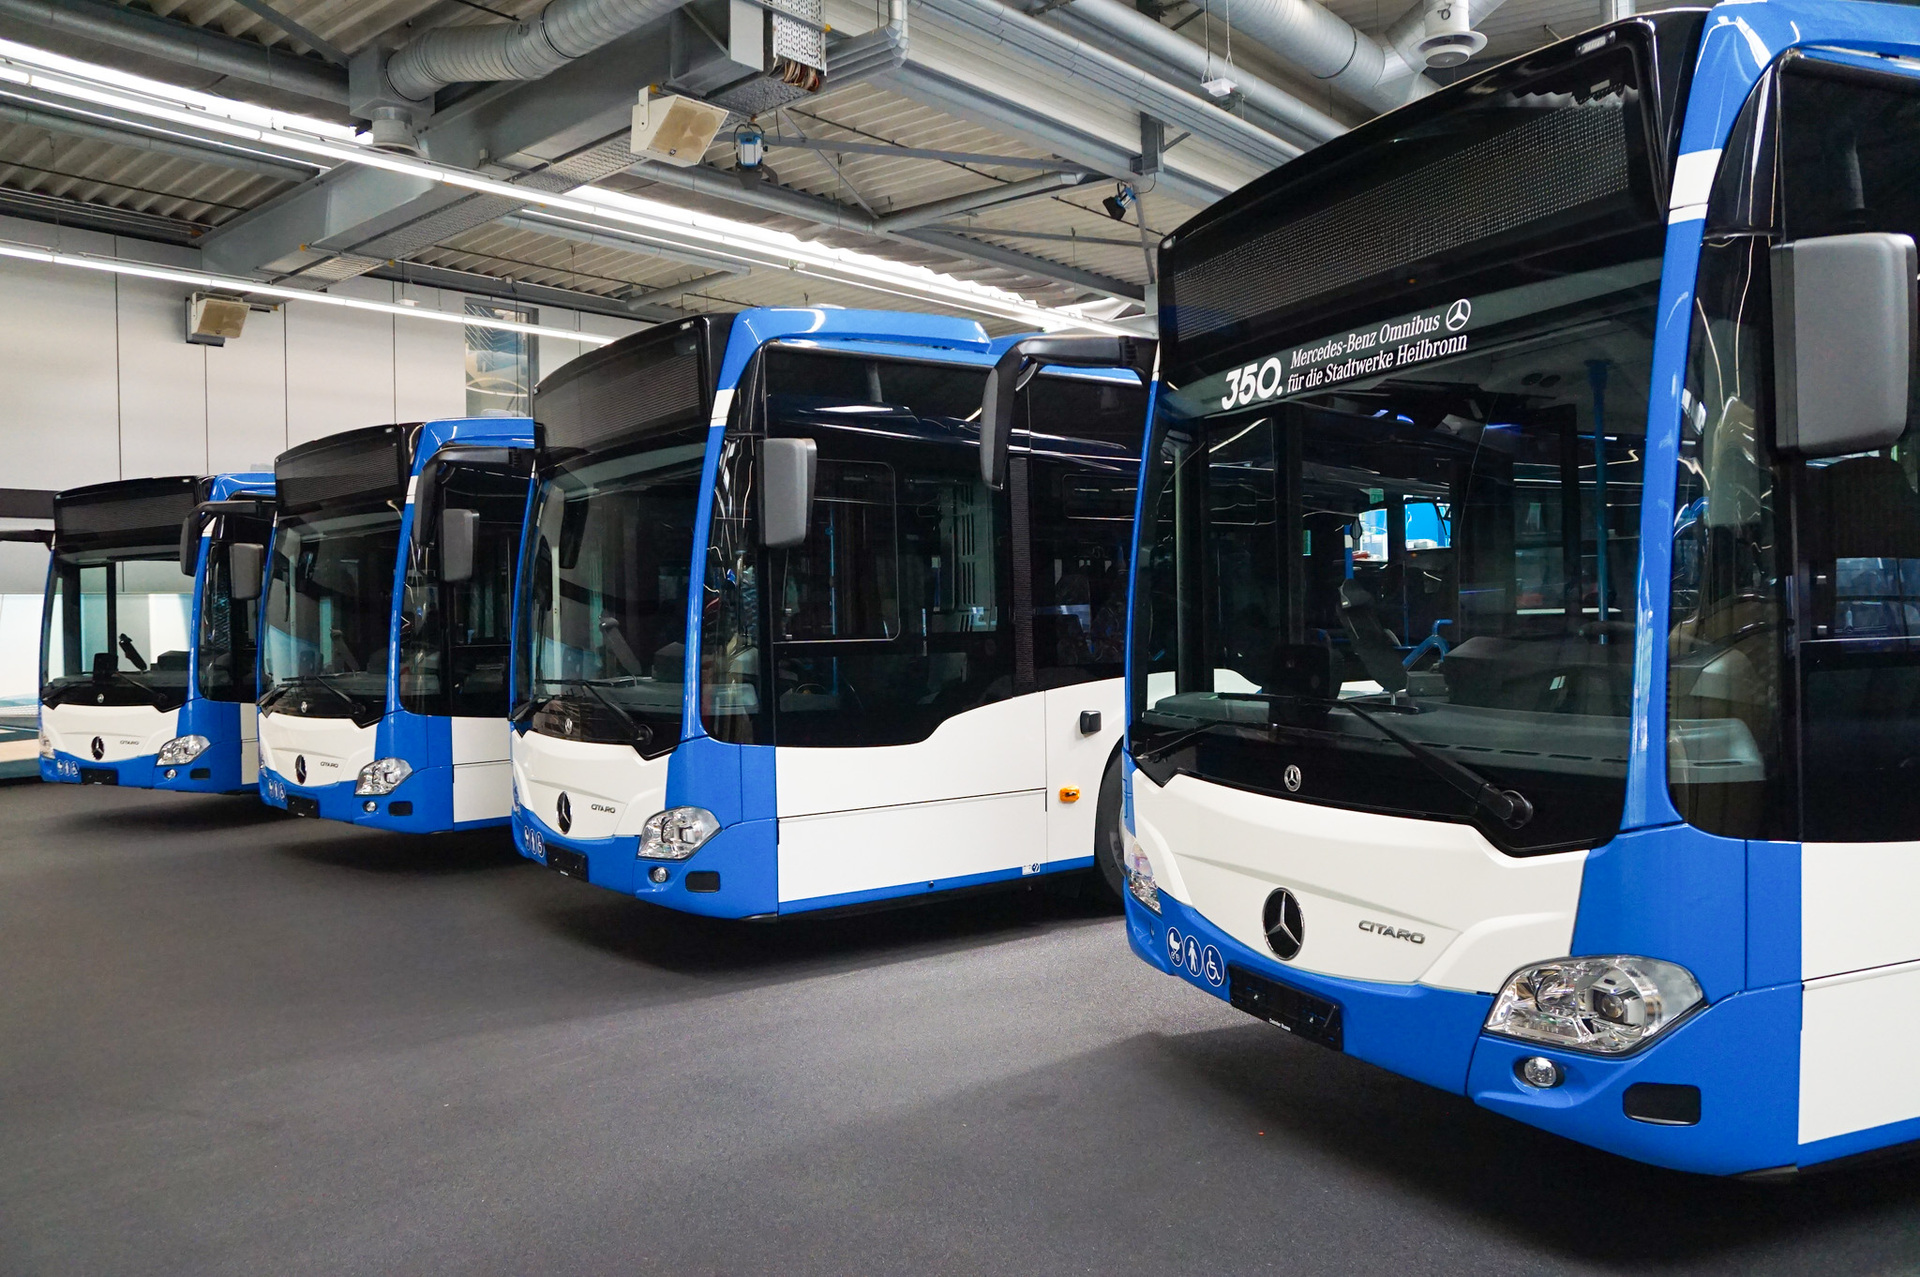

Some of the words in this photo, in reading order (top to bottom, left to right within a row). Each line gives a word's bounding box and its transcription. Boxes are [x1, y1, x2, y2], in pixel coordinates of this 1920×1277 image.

[1287, 374, 1304, 391] für
[1305, 371, 1323, 388] die
[1324, 352, 1394, 383] Stadtwerke
[1395, 335, 1468, 366] Heilbronn
[1290, 331, 1377, 370] Mercedes-Benz
[1379, 313, 1441, 344] Omnibus
[1221, 357, 1283, 411] 350.
[1358, 919, 1426, 945] CITARO
